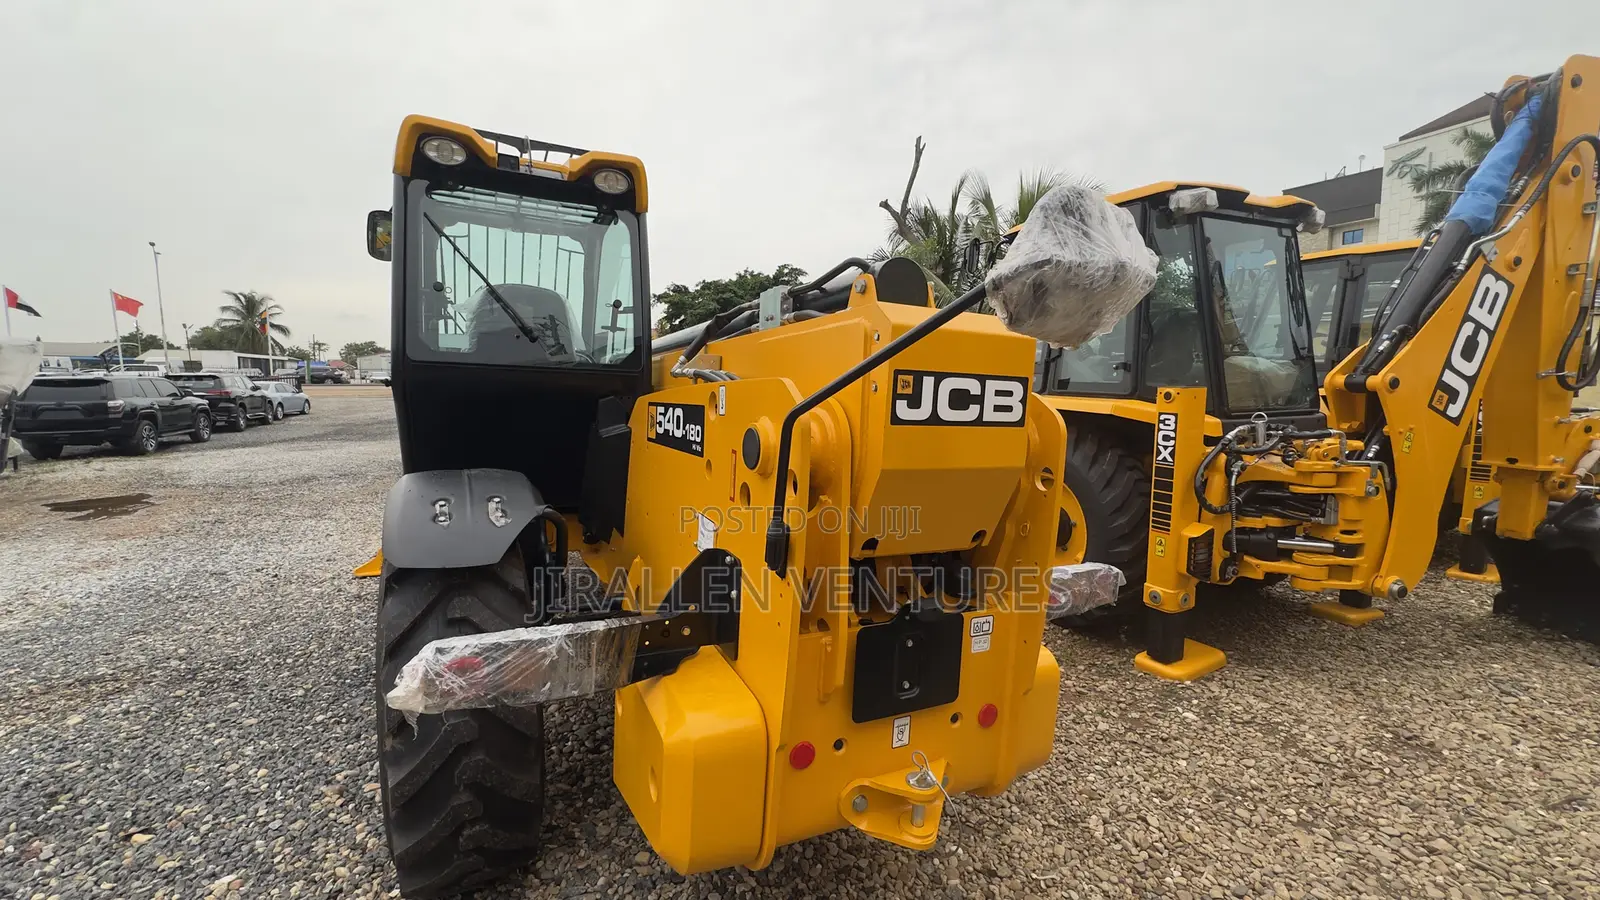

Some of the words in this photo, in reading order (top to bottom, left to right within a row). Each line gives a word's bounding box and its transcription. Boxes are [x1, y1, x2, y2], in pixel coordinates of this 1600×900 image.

[1441, 273, 1508, 418] JCB
[895, 376, 1024, 422] JCB
[656, 406, 702, 442] 540-180
[1156, 414, 1176, 463] 3CX
